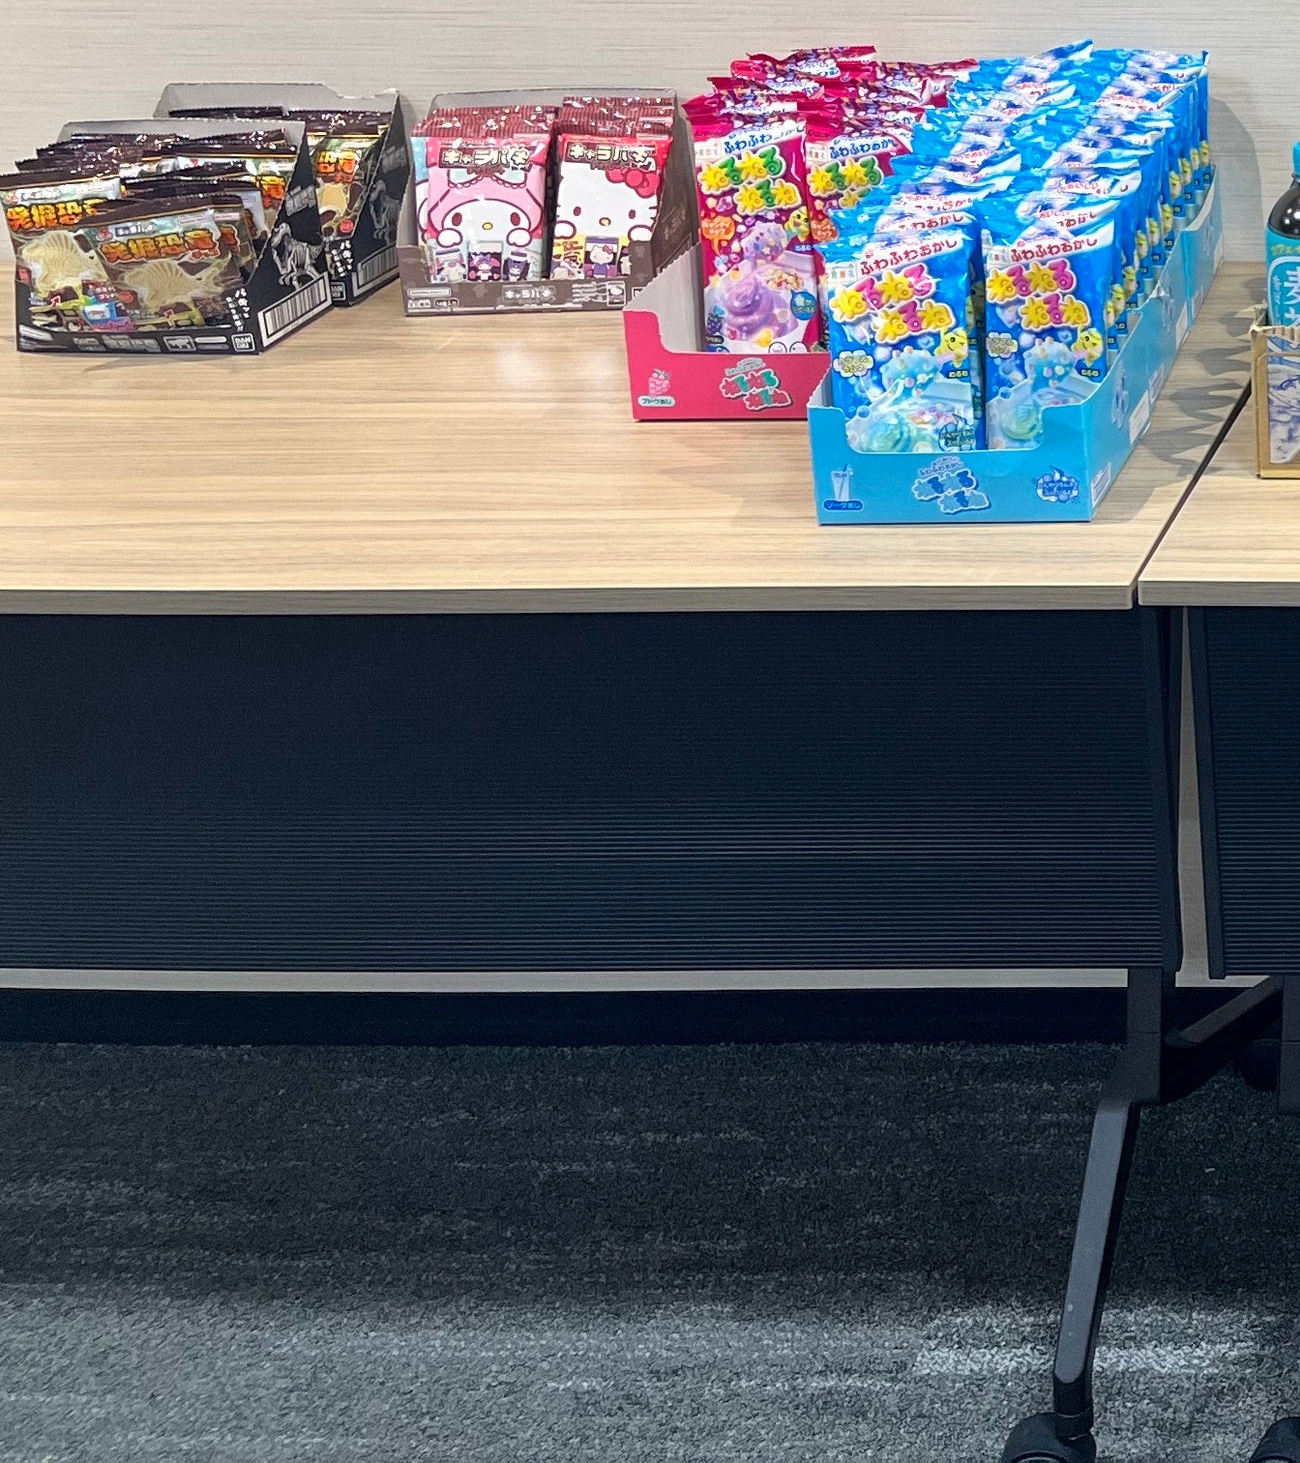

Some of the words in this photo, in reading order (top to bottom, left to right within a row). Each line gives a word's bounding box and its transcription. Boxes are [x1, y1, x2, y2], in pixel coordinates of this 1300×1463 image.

[860, 239, 958, 275] ふわふわおかし
[1011, 238, 1098, 263] ふわふわおかし
